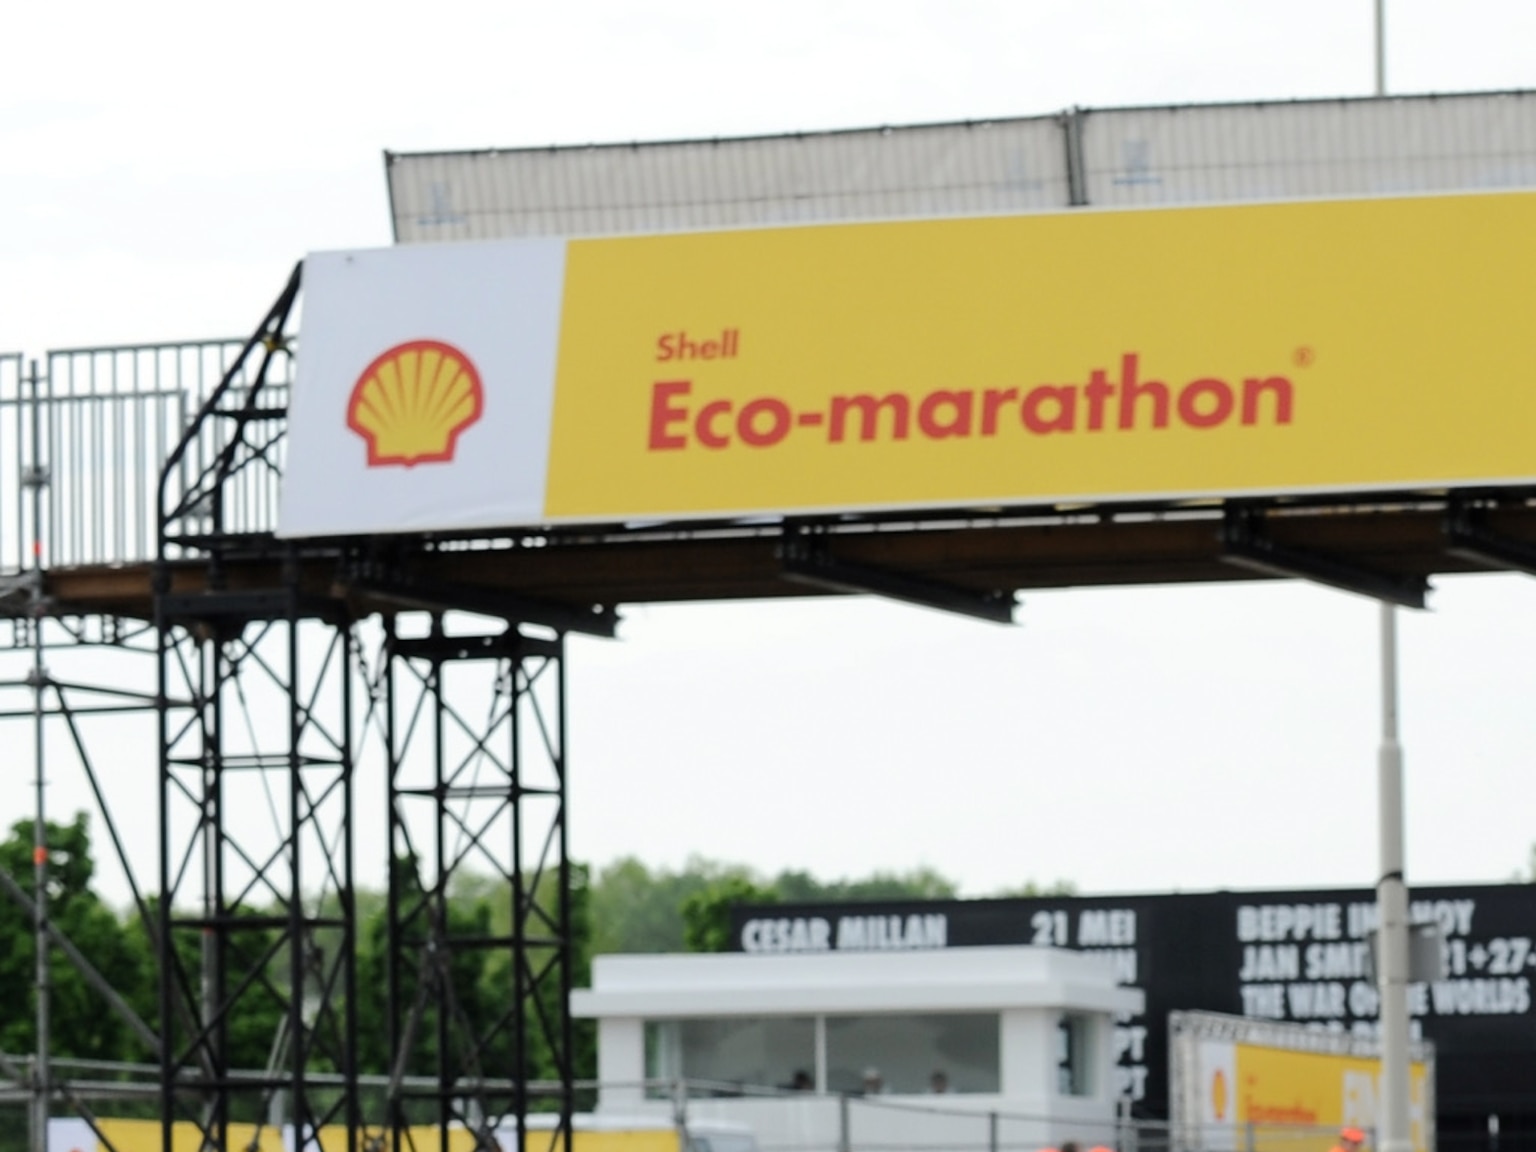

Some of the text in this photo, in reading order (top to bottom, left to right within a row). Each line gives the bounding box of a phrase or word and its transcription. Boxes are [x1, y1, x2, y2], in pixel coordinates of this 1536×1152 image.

[656, 331, 738, 362] Shell
[648, 354, 1294, 452] Eco-marathon
[741, 910, 1136, 952] CESAR MILLAN 21 MEI
[1237, 903, 1342, 941] BEPPIE
[1239, 944, 1299, 980] JAN
[1240, 983, 1284, 1018] THE
[1287, 981, 1346, 1018] WAR
[1431, 978, 1530, 1014] WORLDS
